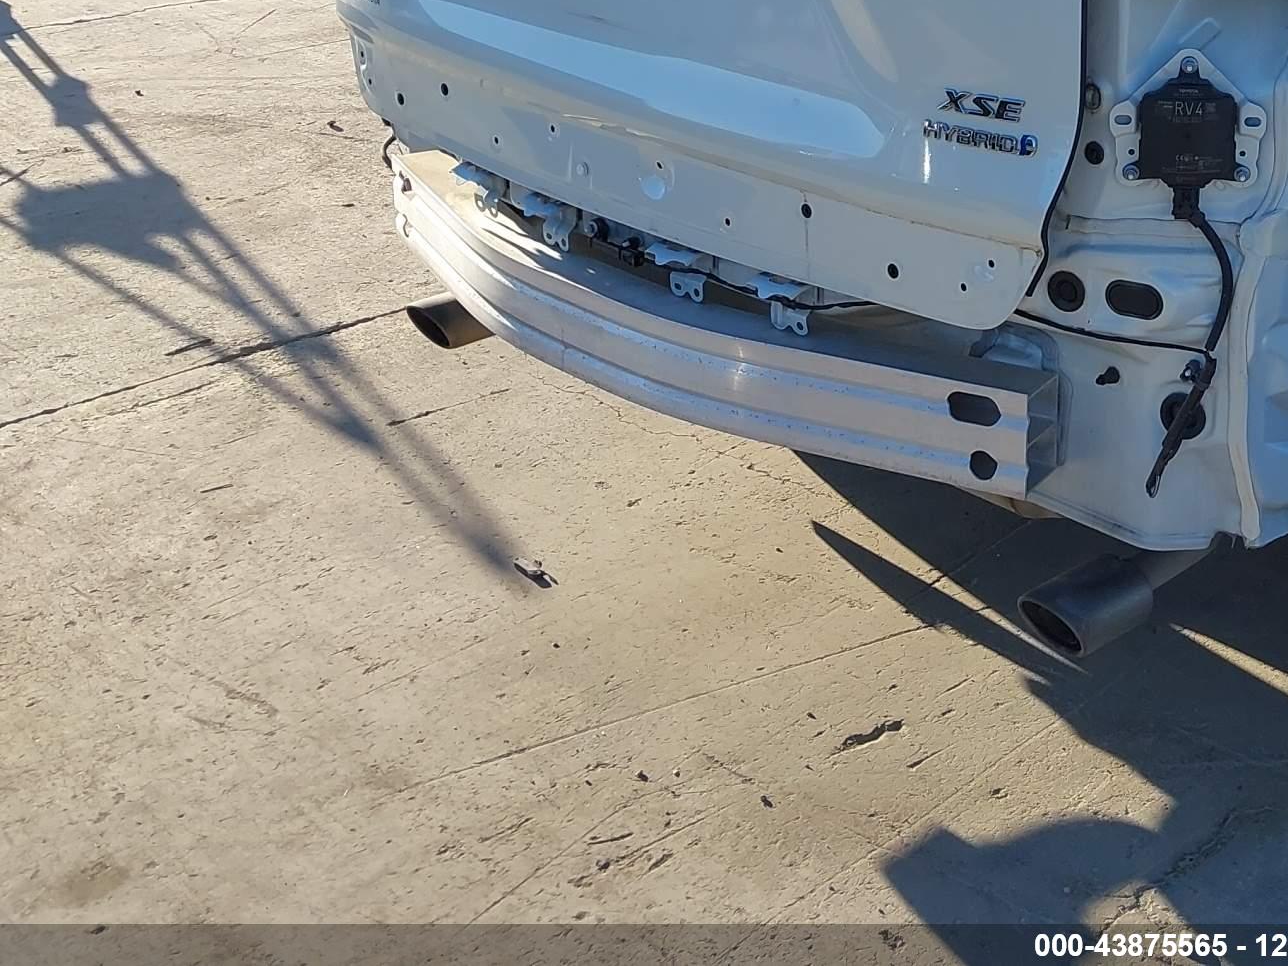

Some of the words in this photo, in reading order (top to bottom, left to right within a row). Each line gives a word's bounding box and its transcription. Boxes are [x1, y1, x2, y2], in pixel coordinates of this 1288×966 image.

[936, 87, 1026, 123] XSE
[1174, 100, 1203, 115] RV4
[922, 118, 1020, 154] HYBRID
